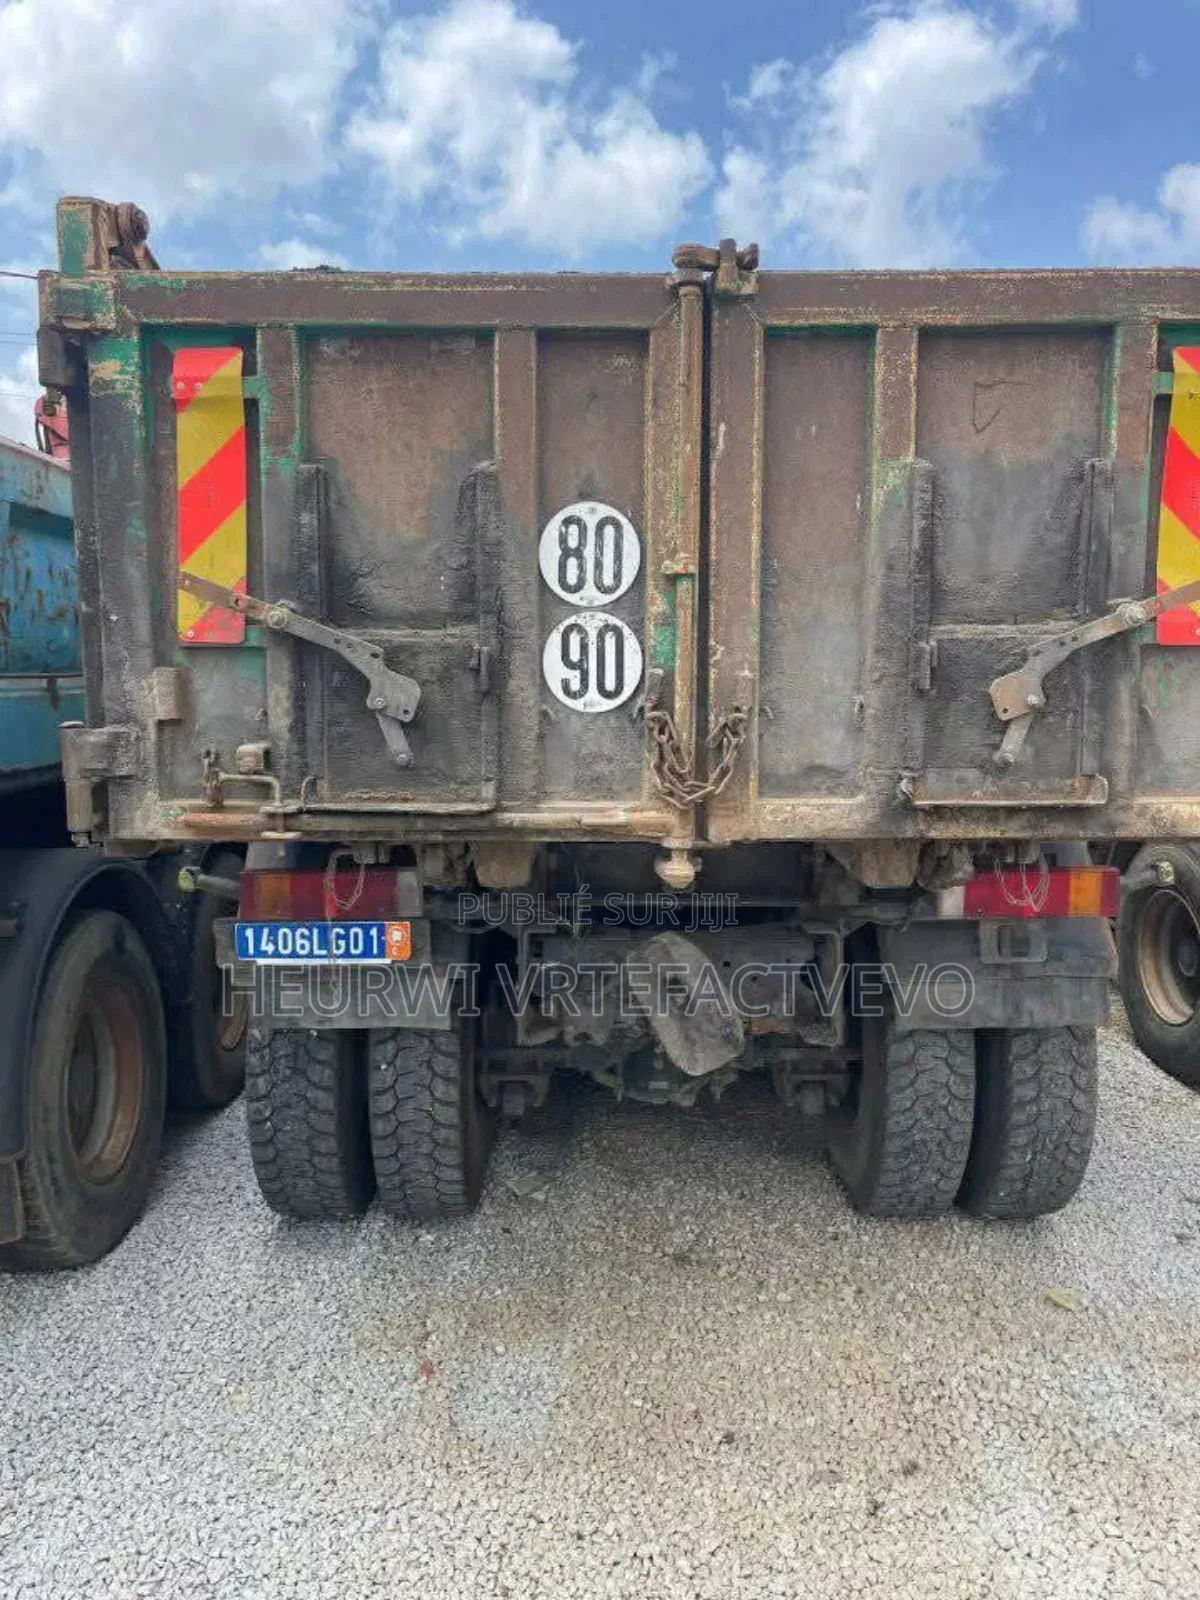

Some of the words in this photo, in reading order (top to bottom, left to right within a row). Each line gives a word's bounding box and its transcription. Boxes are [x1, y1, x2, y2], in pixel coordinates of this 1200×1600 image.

[558, 514, 624, 594] 80
[561, 622, 624, 700] 90
[244, 927, 379, 955] 1406LG01
